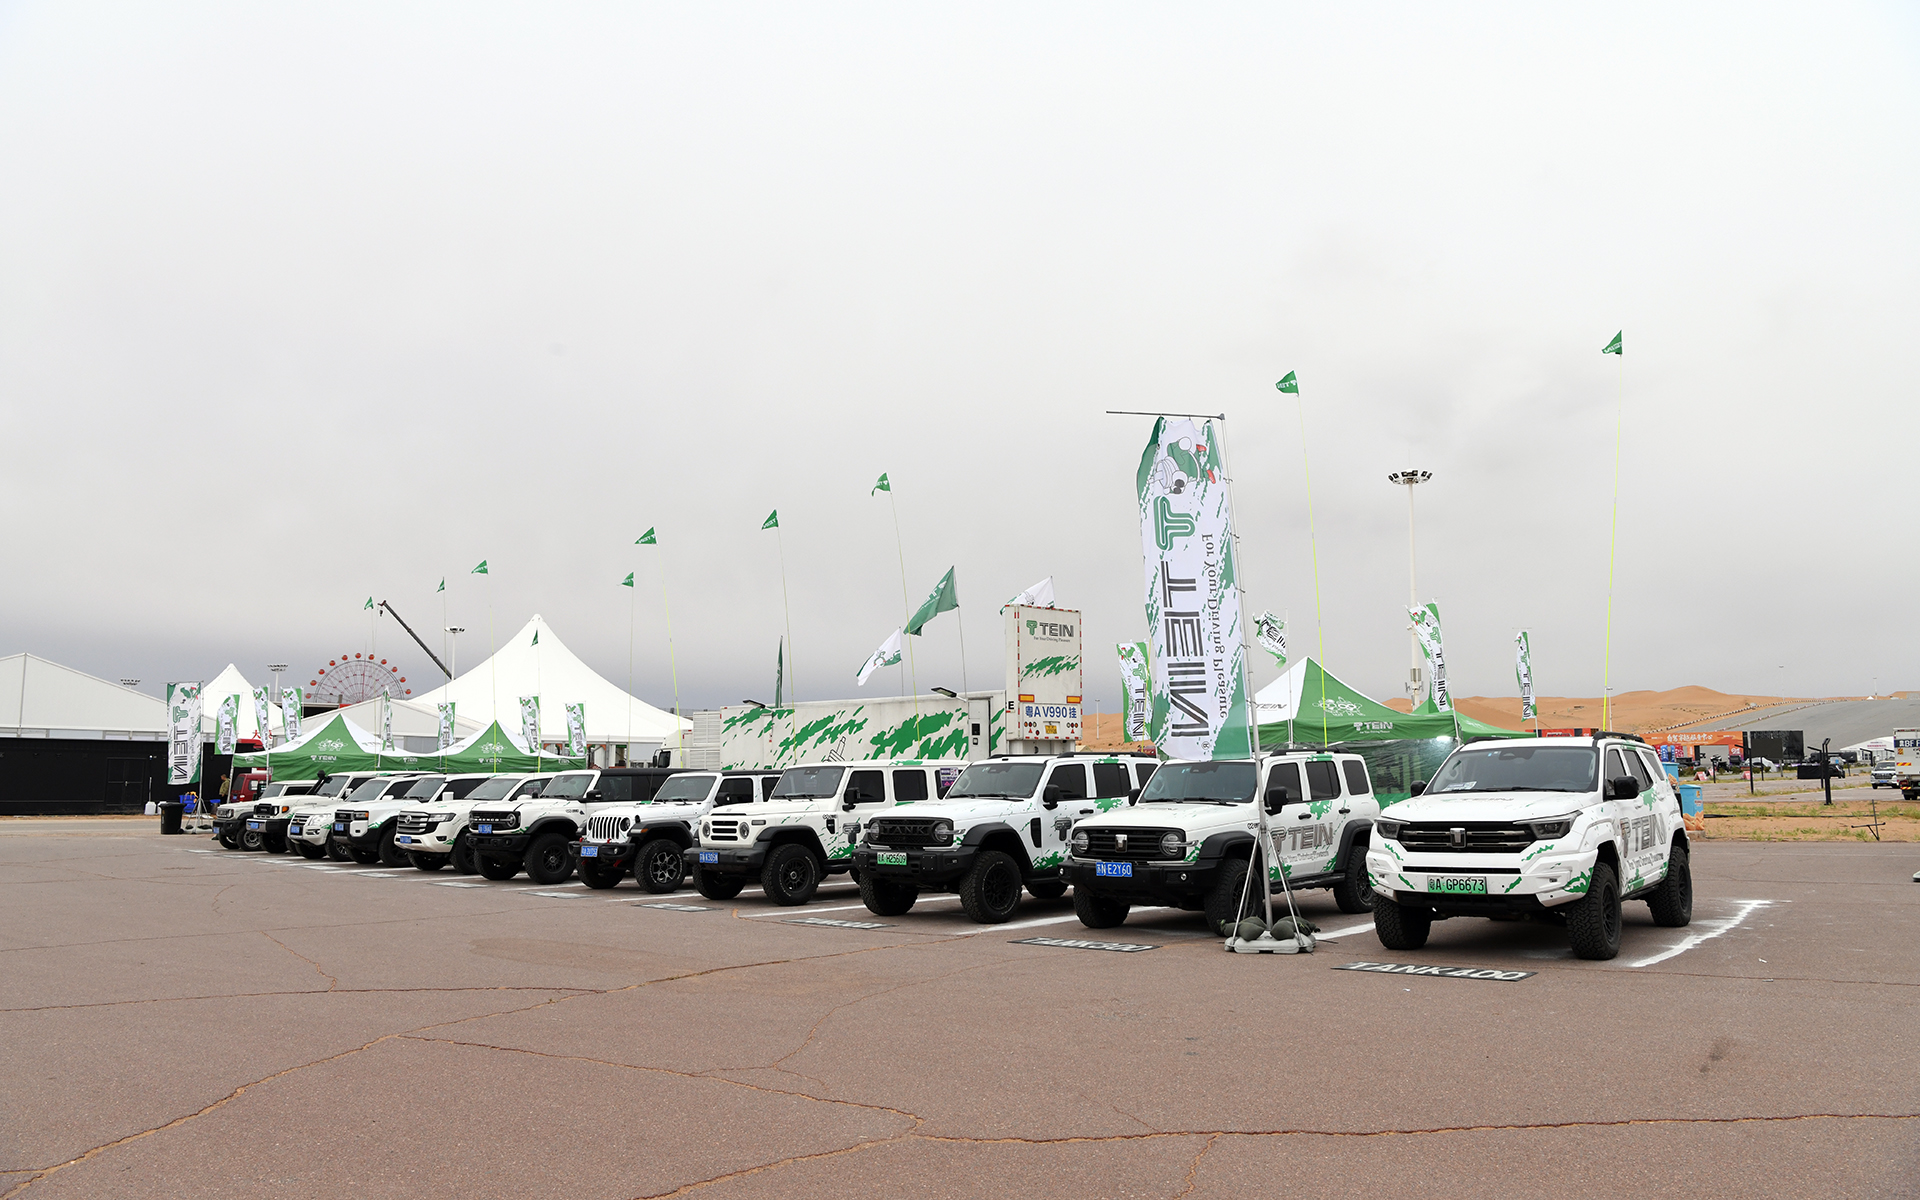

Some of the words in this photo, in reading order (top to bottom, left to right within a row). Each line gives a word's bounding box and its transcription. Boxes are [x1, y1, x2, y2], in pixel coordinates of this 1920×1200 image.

[1040, 622, 1074, 637] TEIN
[1436, 648, 1446, 706] TEIN
[1522, 670, 1531, 718] TEIN
[1133, 684, 1146, 736] TEIN
[222, 719, 232, 752] TEIN
[884, 825, 926, 834] TANK
[1288, 822, 1334, 850] TEIN
[1631, 813, 1667, 852] TEIN
